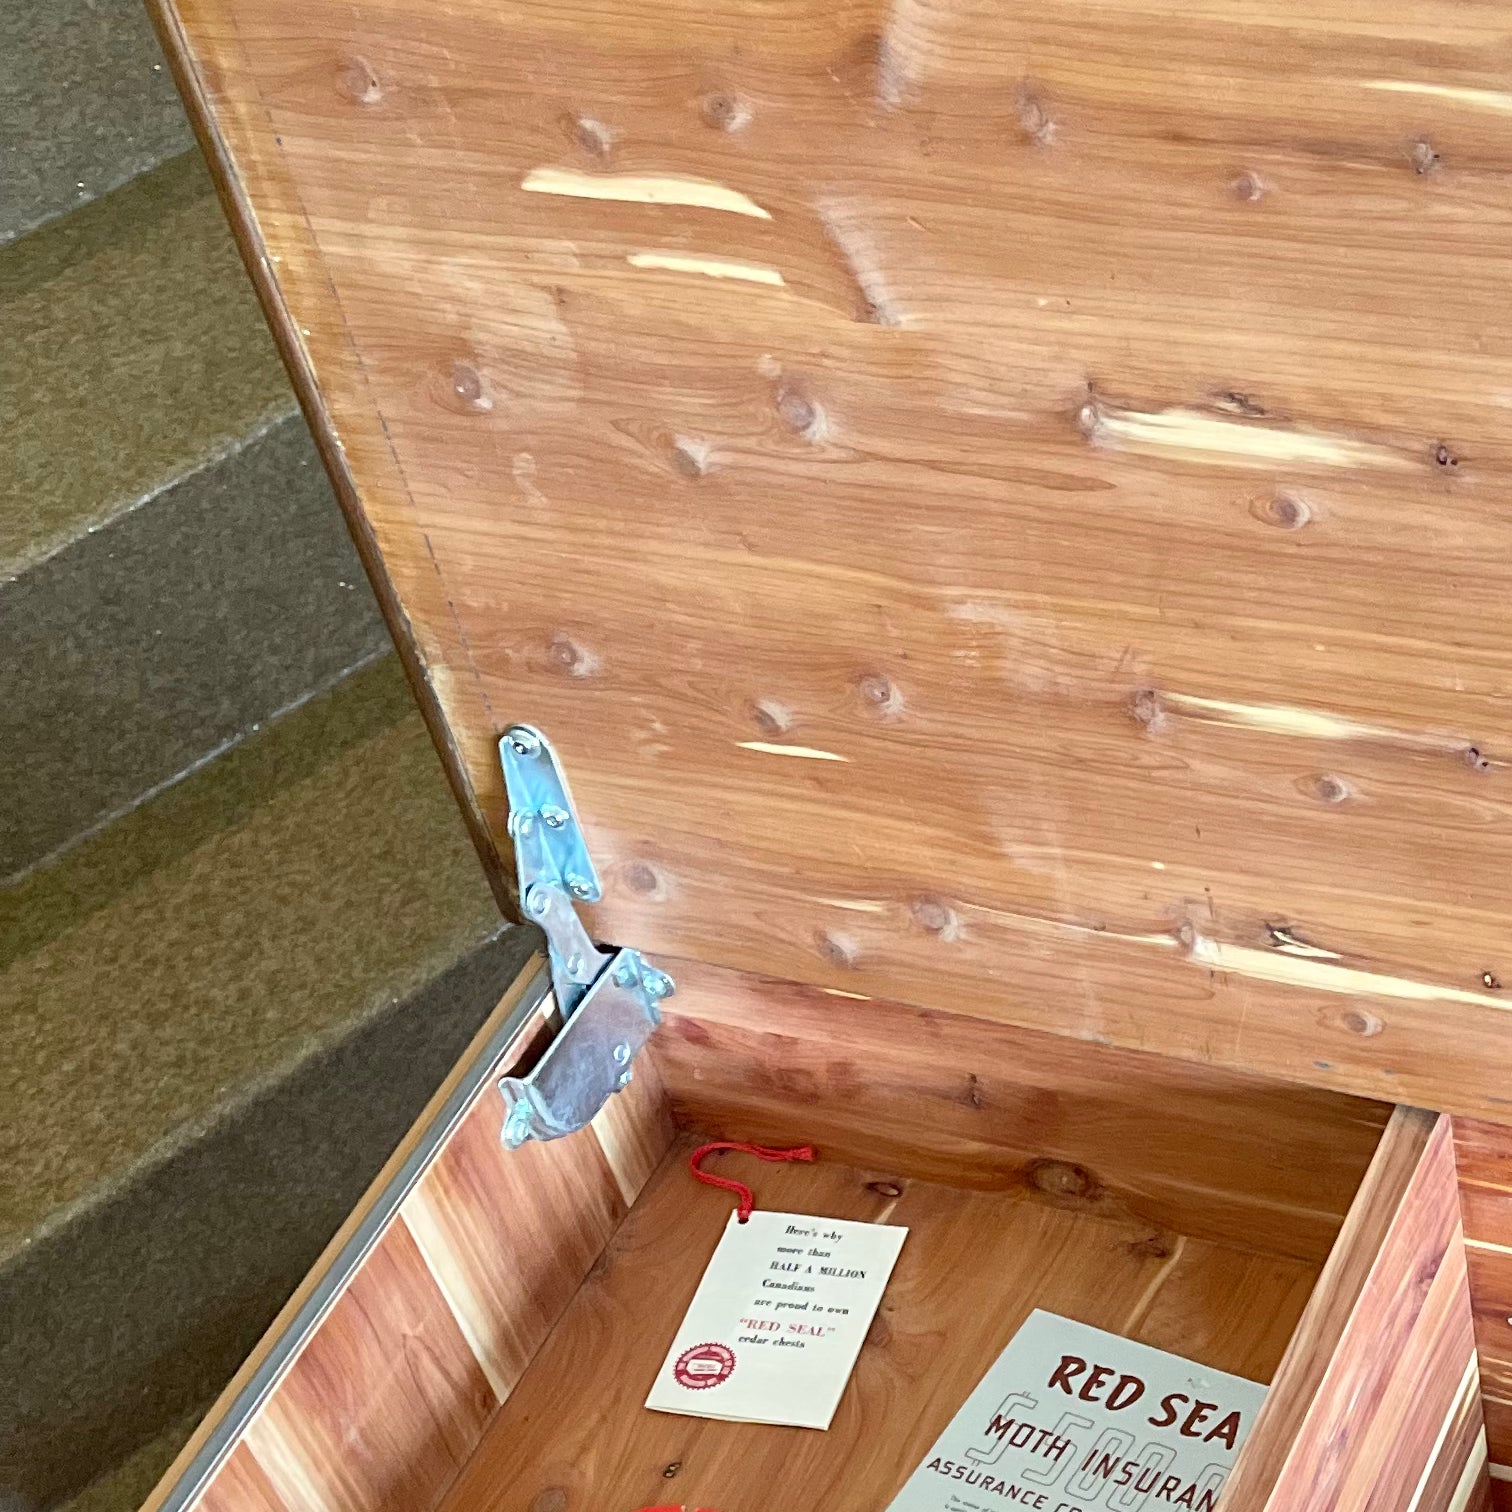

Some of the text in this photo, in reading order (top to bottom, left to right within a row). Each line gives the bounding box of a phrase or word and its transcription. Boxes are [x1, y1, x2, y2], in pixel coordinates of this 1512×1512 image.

[785, 1225, 843, 1243] Here's why
[777, 1247, 831, 1258] more than
[770, 1261, 867, 1279] HALF A MILLION
[762, 1279, 815, 1292] Canadians
[775, 1302, 808, 1310] proud
[738, 1334, 806, 1349] cedar chests
[1048, 1354, 1241, 1451] RED SEA
[985, 1414, 1072, 1462] MOTH
[927, 1457, 1049, 1511] ASSURANCE
